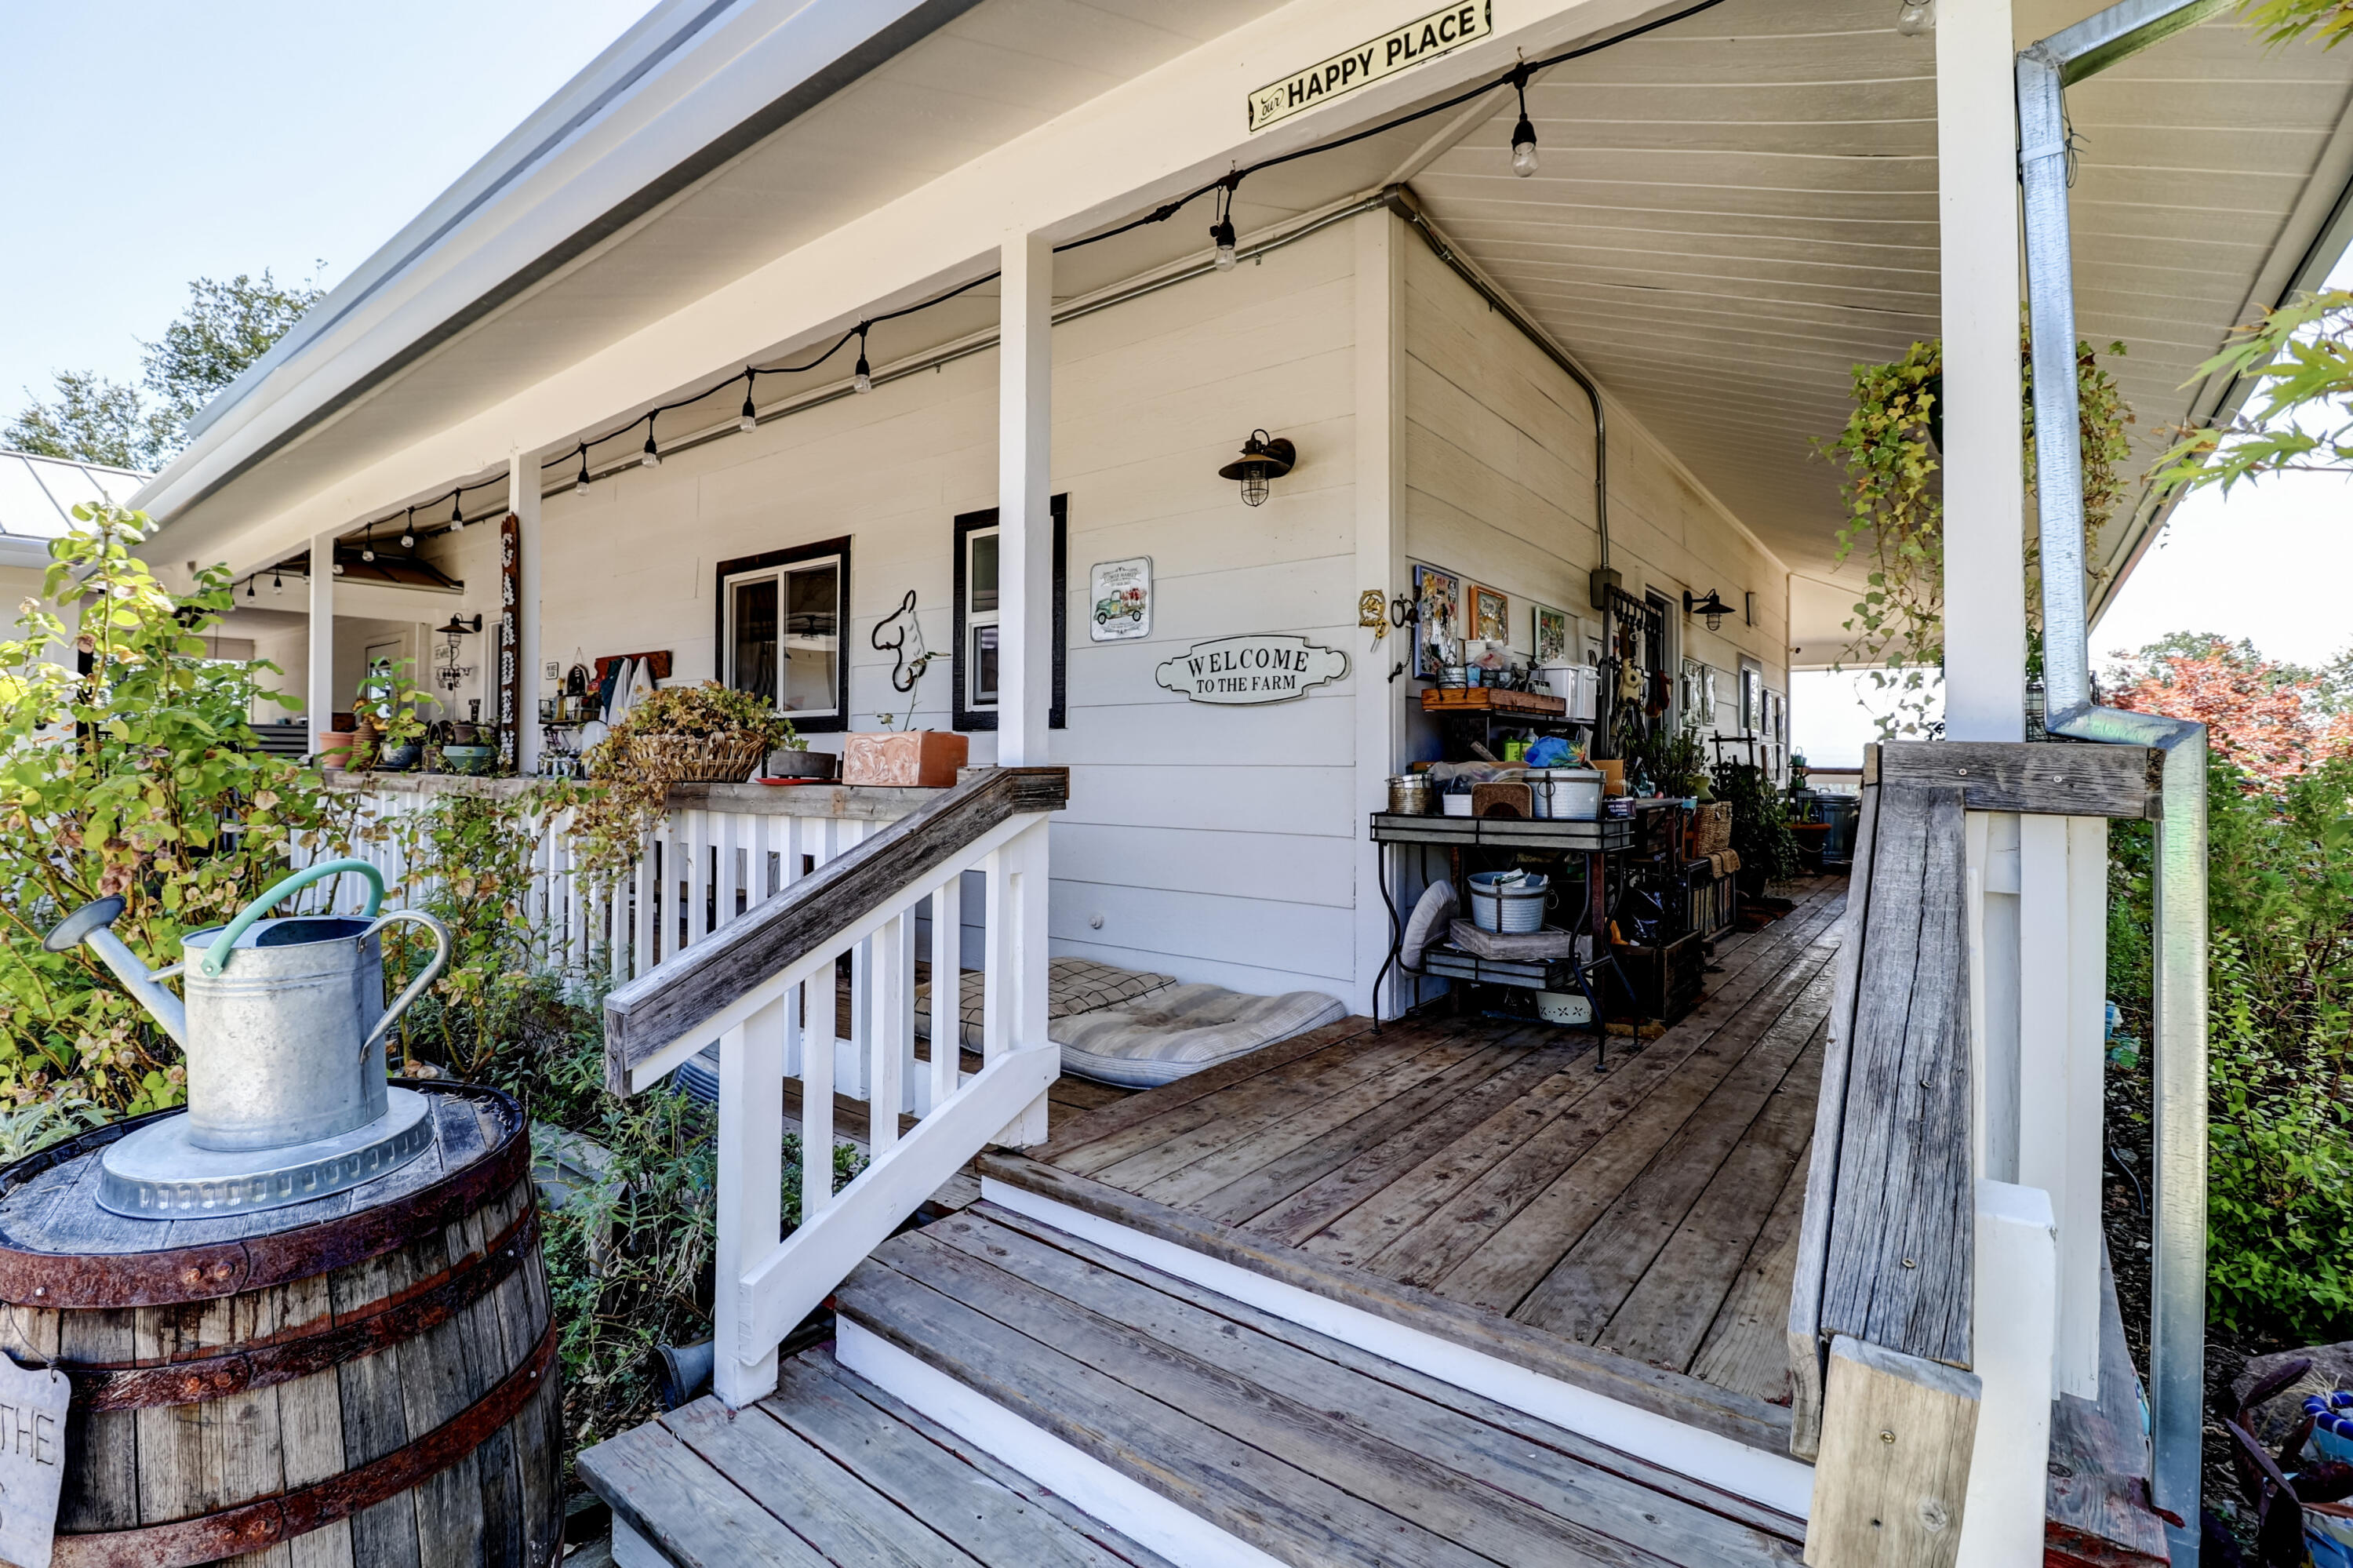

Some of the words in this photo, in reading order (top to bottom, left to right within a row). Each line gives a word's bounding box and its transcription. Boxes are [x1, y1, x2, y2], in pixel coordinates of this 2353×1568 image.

[1260, 92, 1282, 118] our
[1287, 48, 1374, 107] HAPPY
[1386, 6, 1475, 67] PLACE
[500, 533, 515, 765] GARDEN
[1187, 648, 1309, 678] WELCOME
[1196, 678, 1215, 693] TO
[1217, 677, 1248, 692] THE
[1251, 675, 1297, 691] FARM
